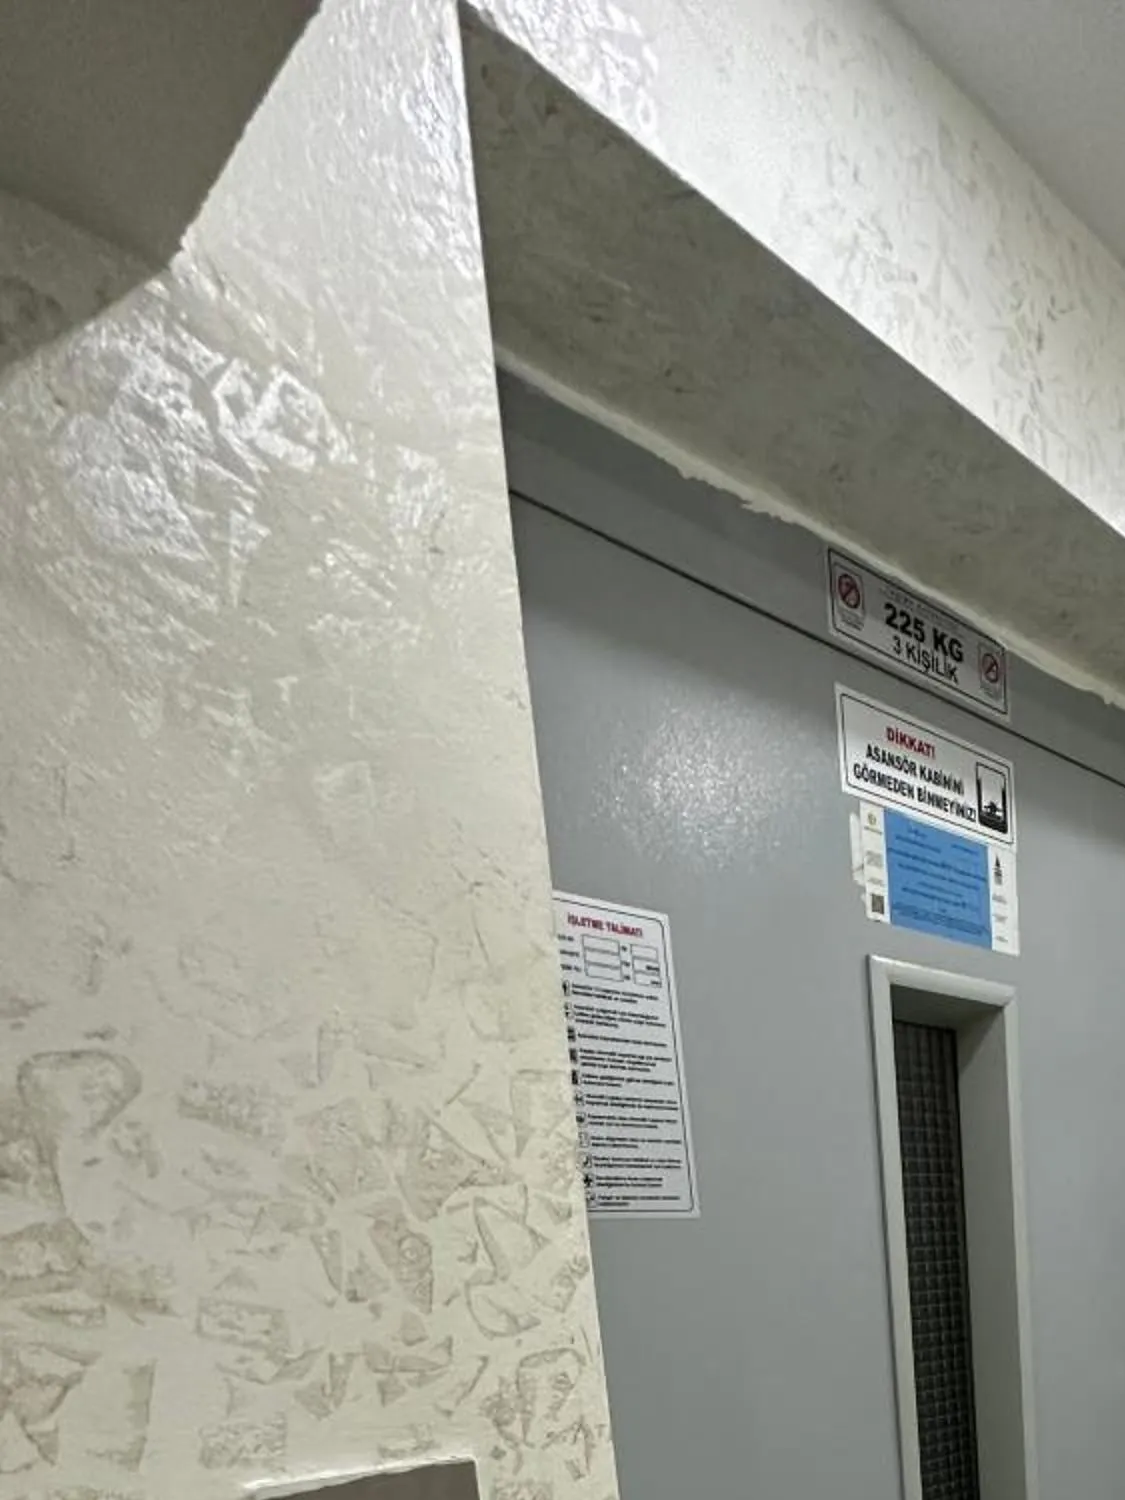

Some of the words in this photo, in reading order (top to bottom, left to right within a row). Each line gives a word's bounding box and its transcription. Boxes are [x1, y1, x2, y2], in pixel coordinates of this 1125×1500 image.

[884, 602, 926, 643] 225
[932, 628, 964, 663] KG
[893, 636, 901, 655] 3
[905, 642, 959, 685] KİŞİLİK
[853, 763, 914, 799] GÖRMEDEN
[866, 743, 917, 777] ASANSÖR
